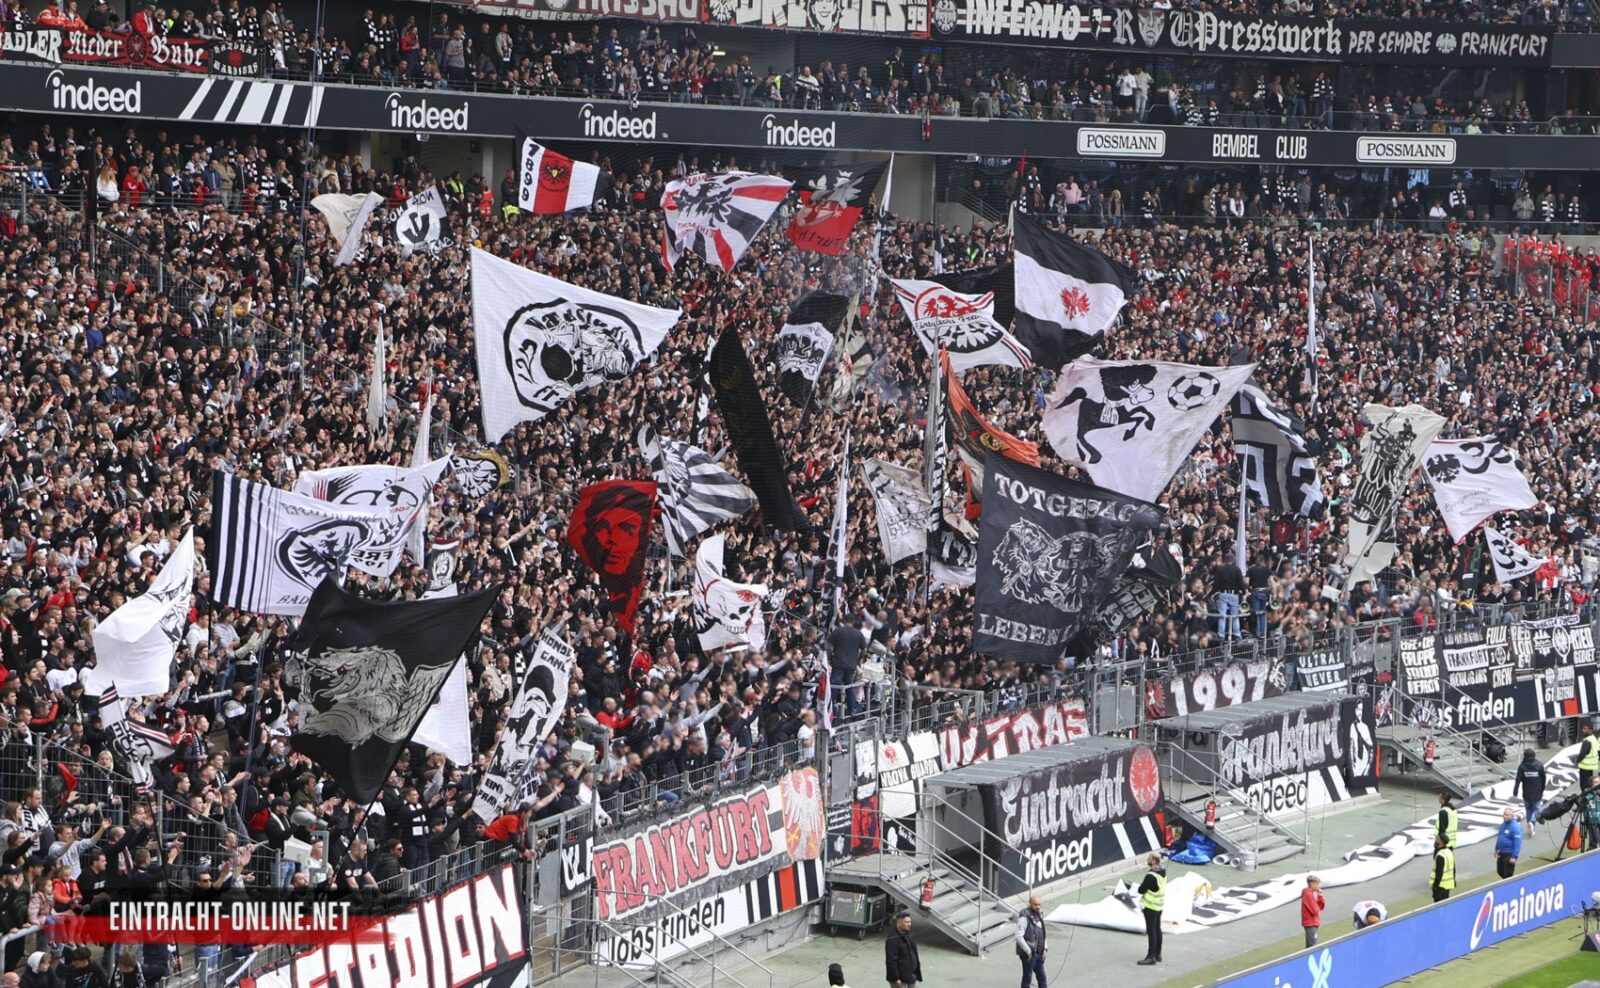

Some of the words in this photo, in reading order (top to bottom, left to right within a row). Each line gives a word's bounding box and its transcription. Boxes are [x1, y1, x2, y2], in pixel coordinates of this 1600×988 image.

[907, 6, 927, 31] 99
[965, 1, 1081, 40] INFERNO
[0, 29, 62, 64] ADLER
[150, 34, 205, 66] Bube
[1348, 30, 1375, 54] PER
[1378, 30, 1432, 56] SEMPRE
[1460, 34, 1548, 58] FRANKFURT
[47, 71, 141, 114] indeed
[386, 93, 469, 131] indeed
[579, 104, 657, 140] indeed
[762, 114, 836, 147] indeed
[1086, 133, 1158, 150] POSSMANN
[1212, 133, 1260, 159] BEMBEL
[1275, 135, 1308, 160] CLUB
[1366, 142, 1446, 159] POSSMANN
[1298, 651, 1341, 668] ULTRAS
[1170, 660, 1271, 717] 1997
[1305, 670, 1341, 688] NEVER
[1458, 692, 1515, 726] finden
[939, 697, 1090, 772] ULTRAS
[1000, 755, 1127, 847] Eintracht
[1243, 771, 1309, 814] ndeed
[594, 789, 773, 920] FRANKFURT
[1019, 829, 1093, 886] indeed
[661, 895, 725, 949] finden
[1492, 882, 1565, 933] mainova
